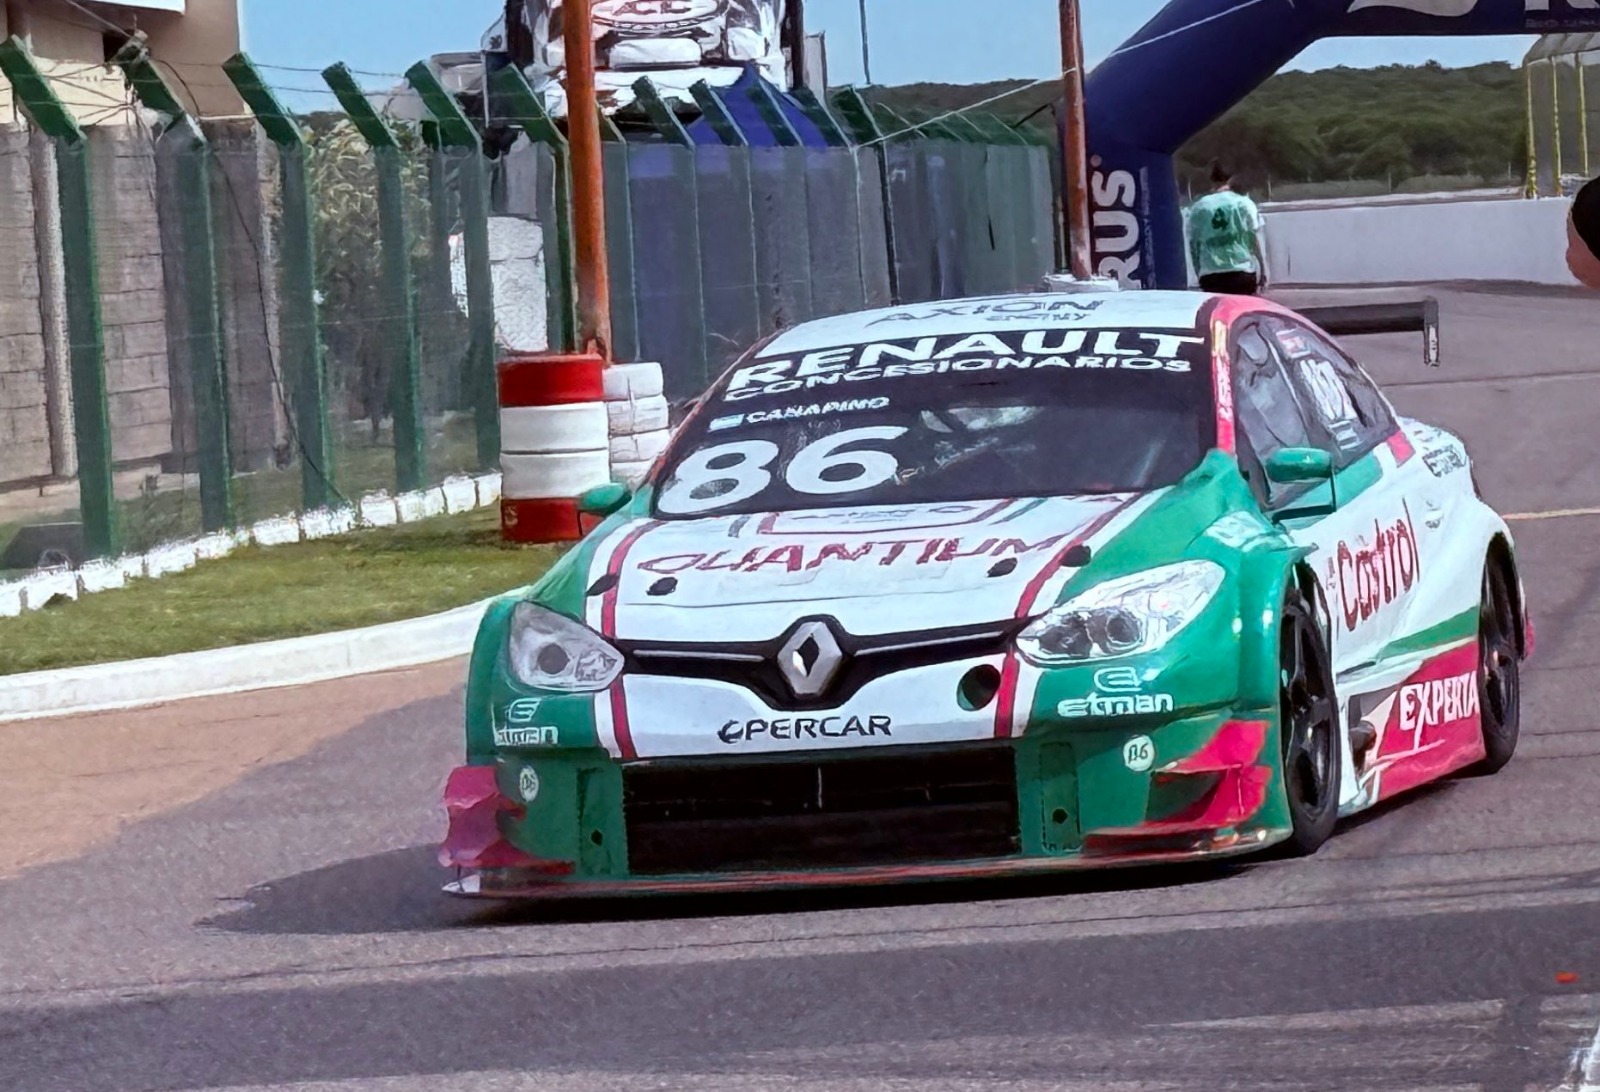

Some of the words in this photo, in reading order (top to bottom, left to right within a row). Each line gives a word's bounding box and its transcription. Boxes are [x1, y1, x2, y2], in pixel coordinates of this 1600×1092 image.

[864, 299, 1106, 329] AXION
[723, 354, 1192, 402] CONCESIONARIOS
[728, 330, 1205, 388] RENAULT
[746, 396, 891, 424] CANAPINO
[657, 425, 909, 515] 86
[637, 535, 1072, 574] QUANTIUM
[1337, 497, 1420, 632] Castrol
[1399, 670, 1480, 749] EXPERTA
